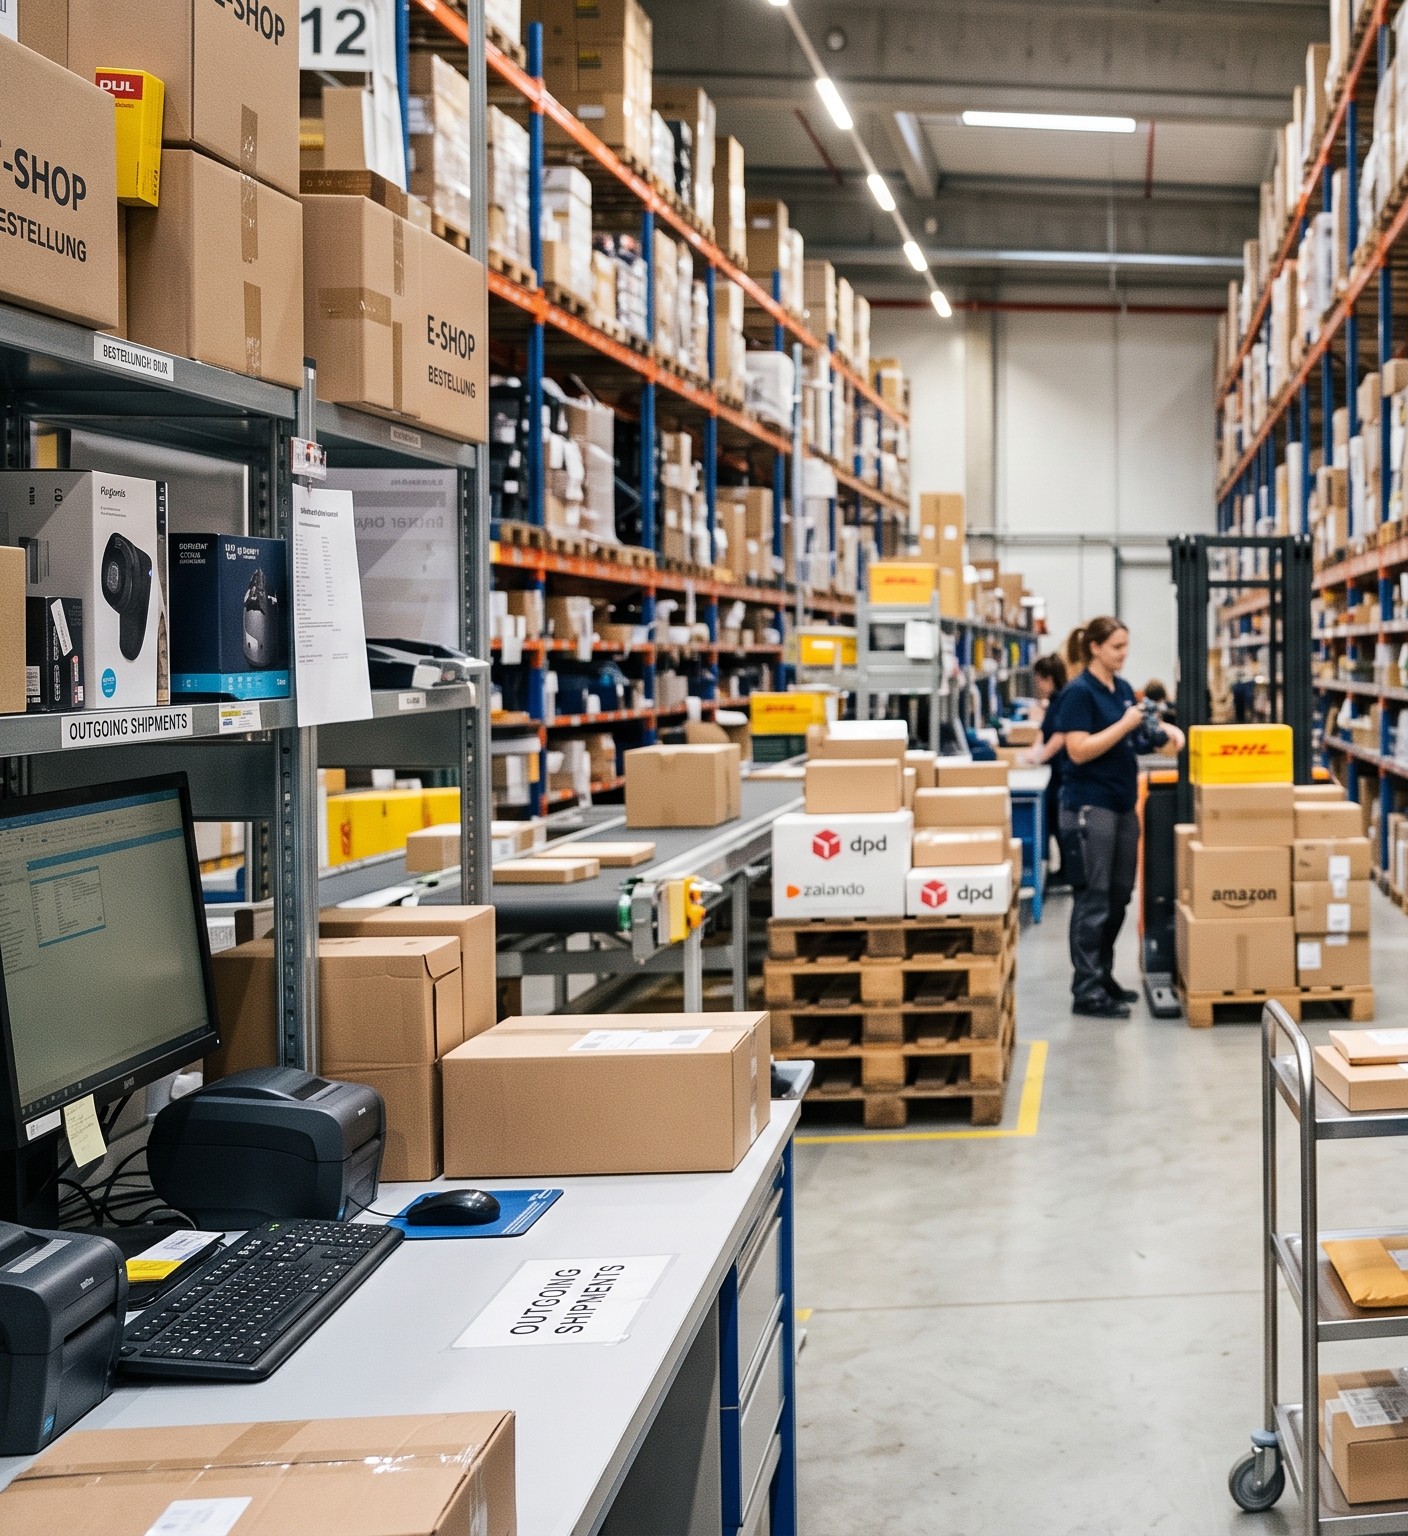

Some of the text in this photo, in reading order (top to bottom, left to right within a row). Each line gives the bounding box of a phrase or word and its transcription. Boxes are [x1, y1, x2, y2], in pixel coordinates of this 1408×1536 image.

[214, 0, 285, 46] -SHOP
[301, 7, 366, 55] 12
[0, 139, 87, 211] -SHOP
[0, 208, 87, 263] ESTELLUNG
[427, 314, 475, 360] E-SHOP
[428, 365, 476, 399] BESTELLUNG
[69, 713, 188, 741] OUTGOING SHIPMENTS
[850, 834, 888, 855] dpd
[957, 883, 993, 904] dpd
[1212, 888, 1278, 901] amazon
[509, 1268, 582, 1335] OUTGOING
